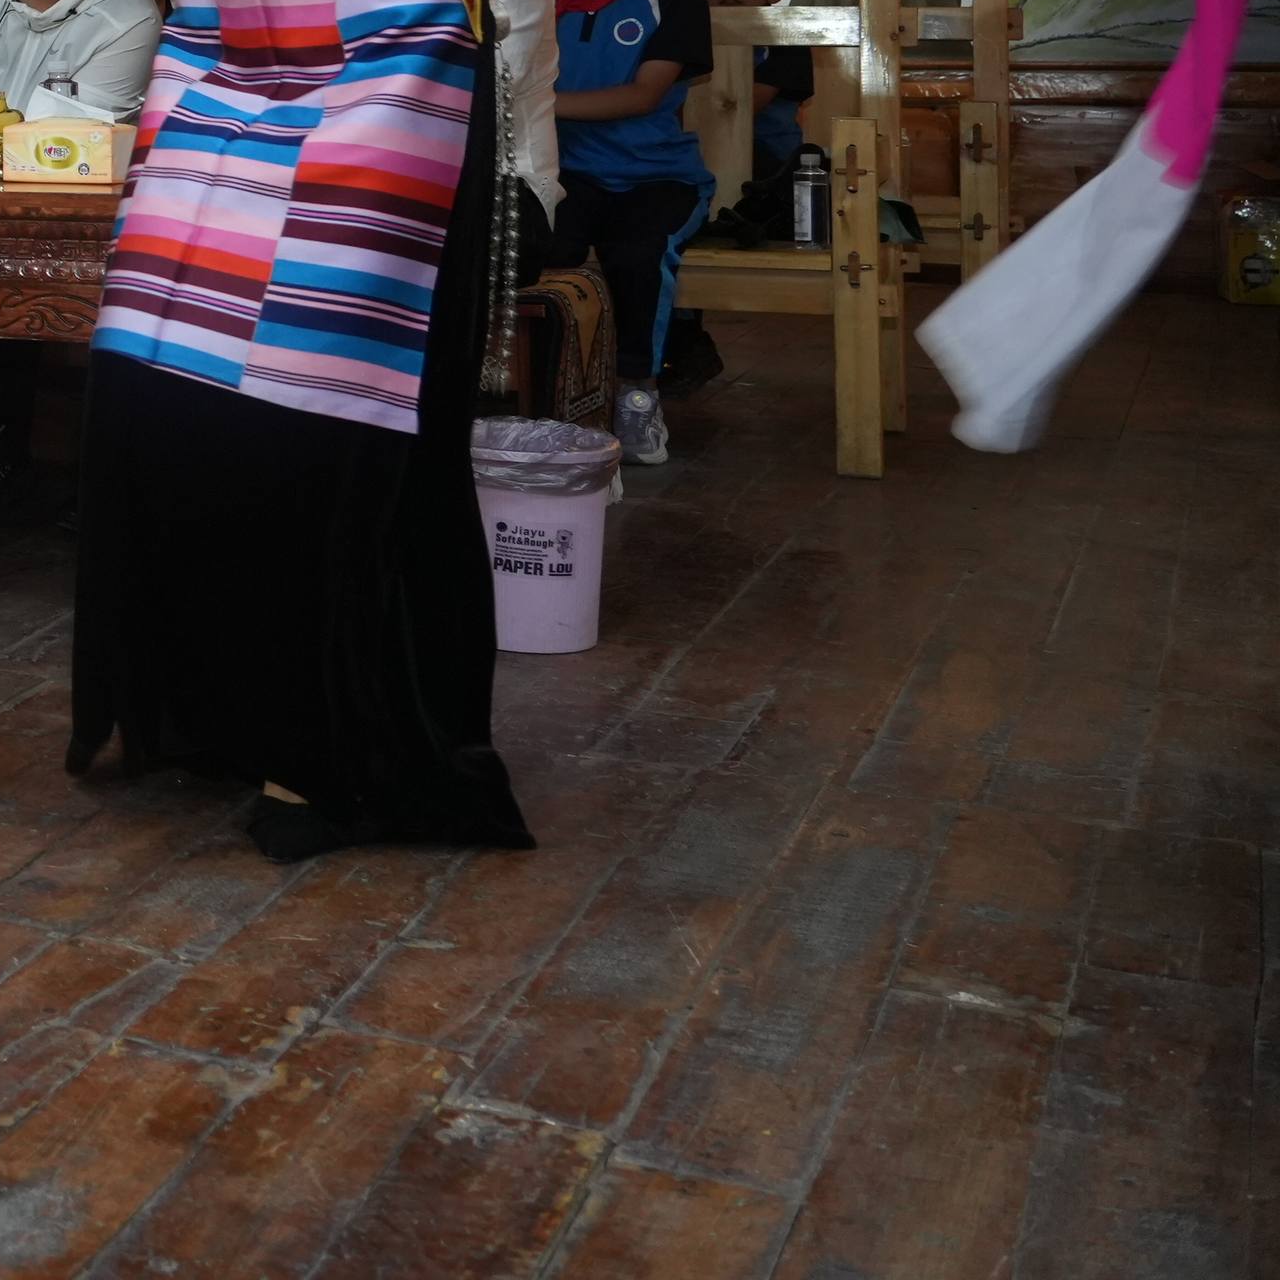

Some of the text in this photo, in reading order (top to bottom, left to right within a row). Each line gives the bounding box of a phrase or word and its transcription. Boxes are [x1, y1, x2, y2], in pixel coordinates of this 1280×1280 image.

[511, 525, 545, 539] Jiayu
[493, 556, 544, 576] PAPER
[548, 563, 573, 574] LOU
